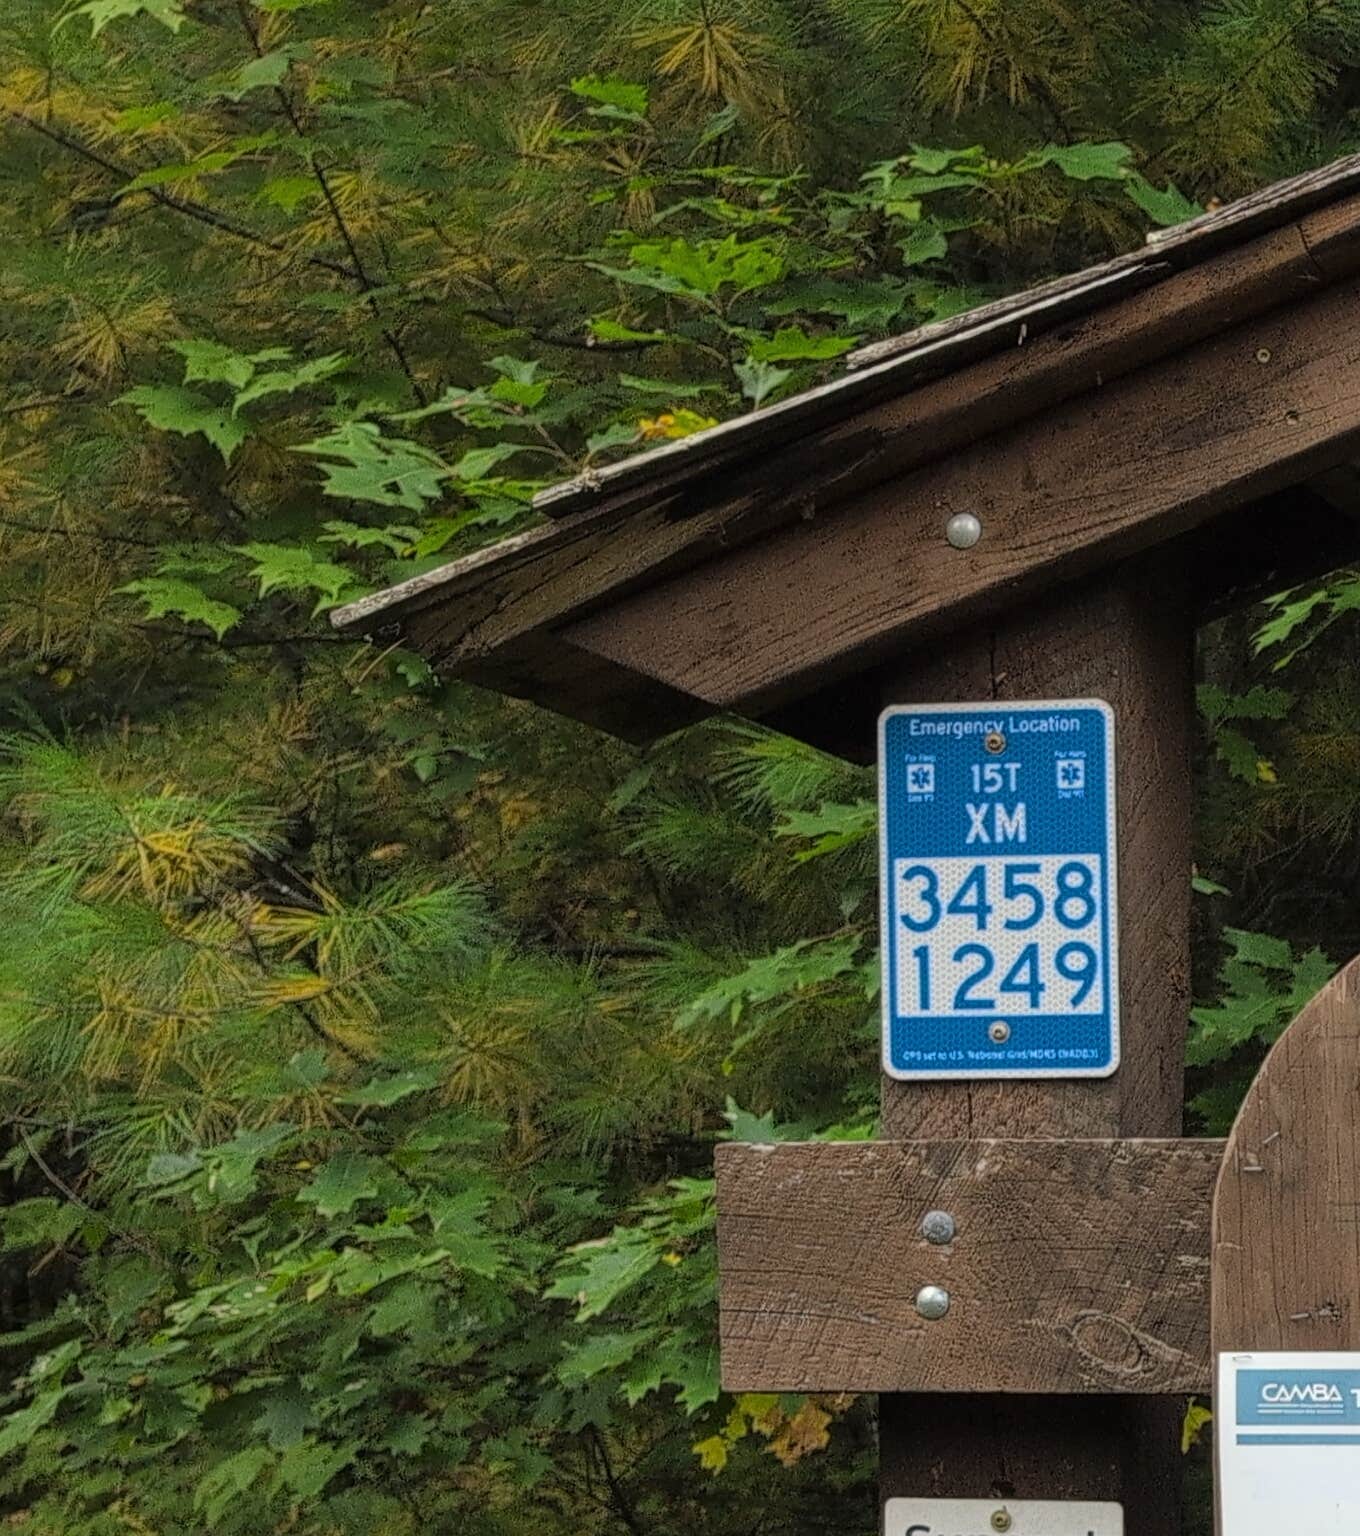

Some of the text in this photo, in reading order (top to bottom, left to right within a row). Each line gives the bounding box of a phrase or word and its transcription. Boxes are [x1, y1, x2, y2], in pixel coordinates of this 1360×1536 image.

[910, 715, 1080, 739] Emergency Location
[971, 764, 1021, 794] 15T
[965, 802, 1027, 844] XM
[901, 862, 1097, 933] 3458
[913, 941, 1098, 1010] 1249
